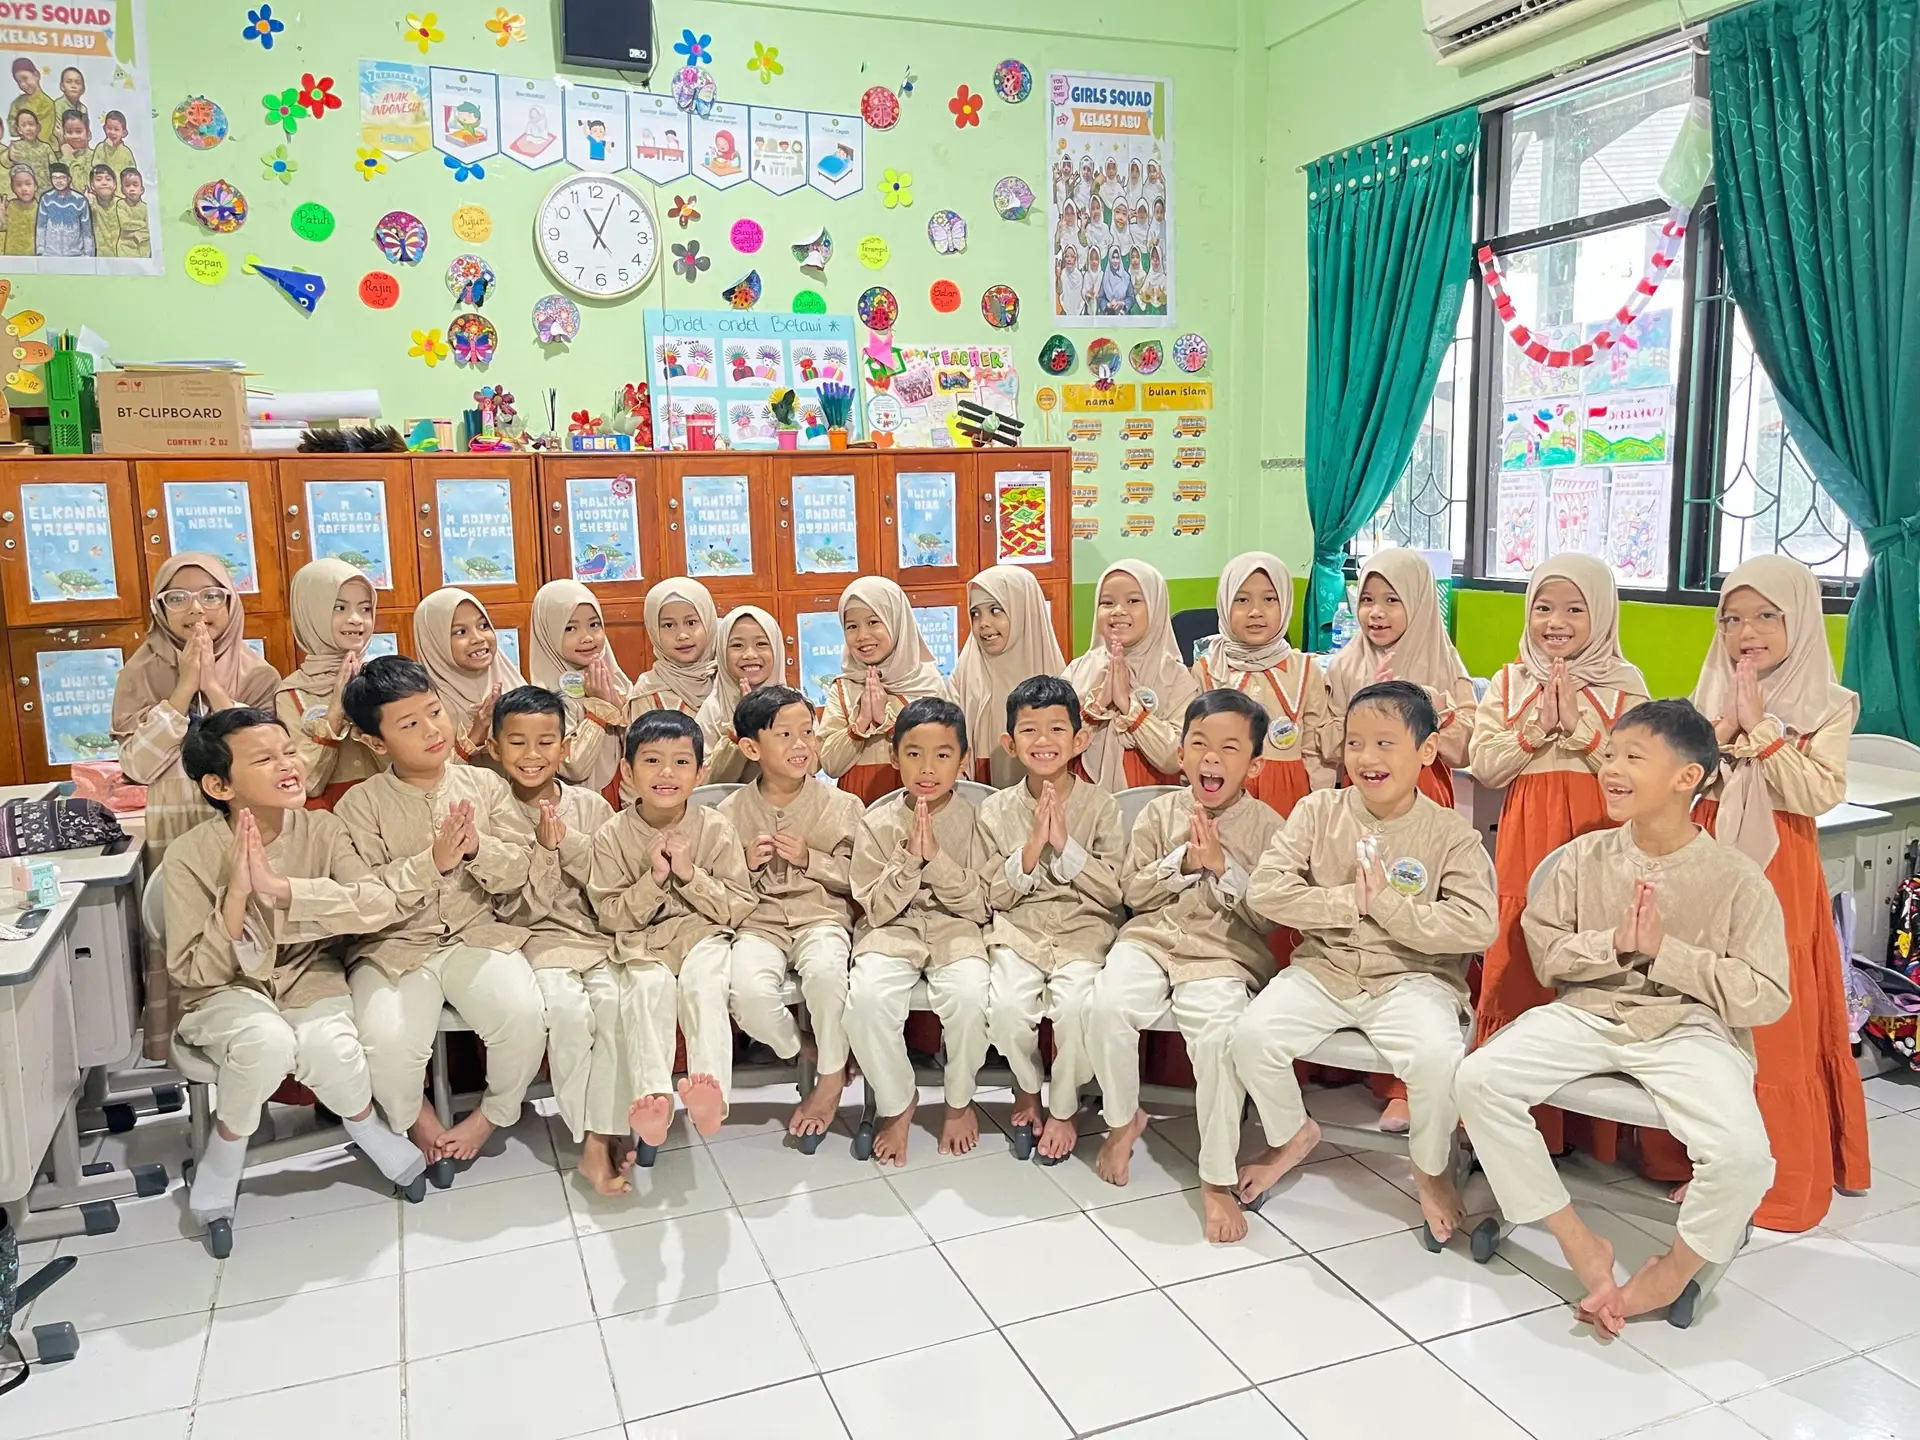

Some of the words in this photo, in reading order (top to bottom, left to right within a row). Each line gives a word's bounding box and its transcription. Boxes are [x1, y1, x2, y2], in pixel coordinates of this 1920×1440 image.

[42, 5, 111, 25] SQUAD
[0, 28, 48, 46] KELAS
[51, 32, 59, 46] 1
[62, 33, 95, 49] ABU
[382, 92, 409, 103] ANAK
[1071, 86, 1107, 104] GIRLS
[1109, 89, 1152, 106] SQUAD
[372, 102, 421, 115] INDONESIA
[1079, 112, 1111, 127] KELAS
[1112, 114, 1118, 127] 1
[1120, 114, 1141, 129] ABU
[570, 190, 579, 204] 11
[588, 185, 603, 199] 12
[615, 193, 621, 206] 1
[299, 209, 331, 226] Patuh
[554, 206, 571, 220] 10
[629, 209, 640, 223] 2
[457, 213, 485, 229] Jujur
[548, 227, 560, 241] 9
[637, 231, 649, 245] 3
[189, 255, 223, 271] Sopan
[557, 250, 569, 263] 8
[631, 253, 642, 266] 4
[574, 266, 585, 280] 7
[595, 273, 607, 286] 6
[618, 268, 629, 281] 5
[363, 281, 393, 298] Rajin
[663, 315, 706, 332] Ondel
[718, 318, 760, 333] ondel
[771, 315, 822, 332] Betawi
[930, 350, 1004, 368] TEACHER
[1148, 386, 1177, 396] bulan
[1180, 386, 1207, 396] islam
[1085, 397, 1115, 406] nama
[117, 407, 223, 419] BT-CLIPBOARD
[167, 438, 202, 446] CONTENT
[209, 437, 217, 446] 2
[804, 494, 847, 507] ALIFIA
[906, 488, 946, 499] ALIYAH
[29, 505, 107, 520] ELKANAH
[175, 506, 242, 517] MUHAMMAD
[322, 511, 373, 523] ARSYAD
[805, 508, 847, 521] ANDRA
[188, 518, 233, 530] NABIL
[462, 513, 510, 525] ADITYA
[31, 522, 108, 537] TRISTAN
[317, 524, 381, 535] RAFFASYA
[443, 525, 512, 538] ALGHIFARI
[798, 521, 855, 535] AZZAHRA
[45, 689, 115, 704] NARENDR
